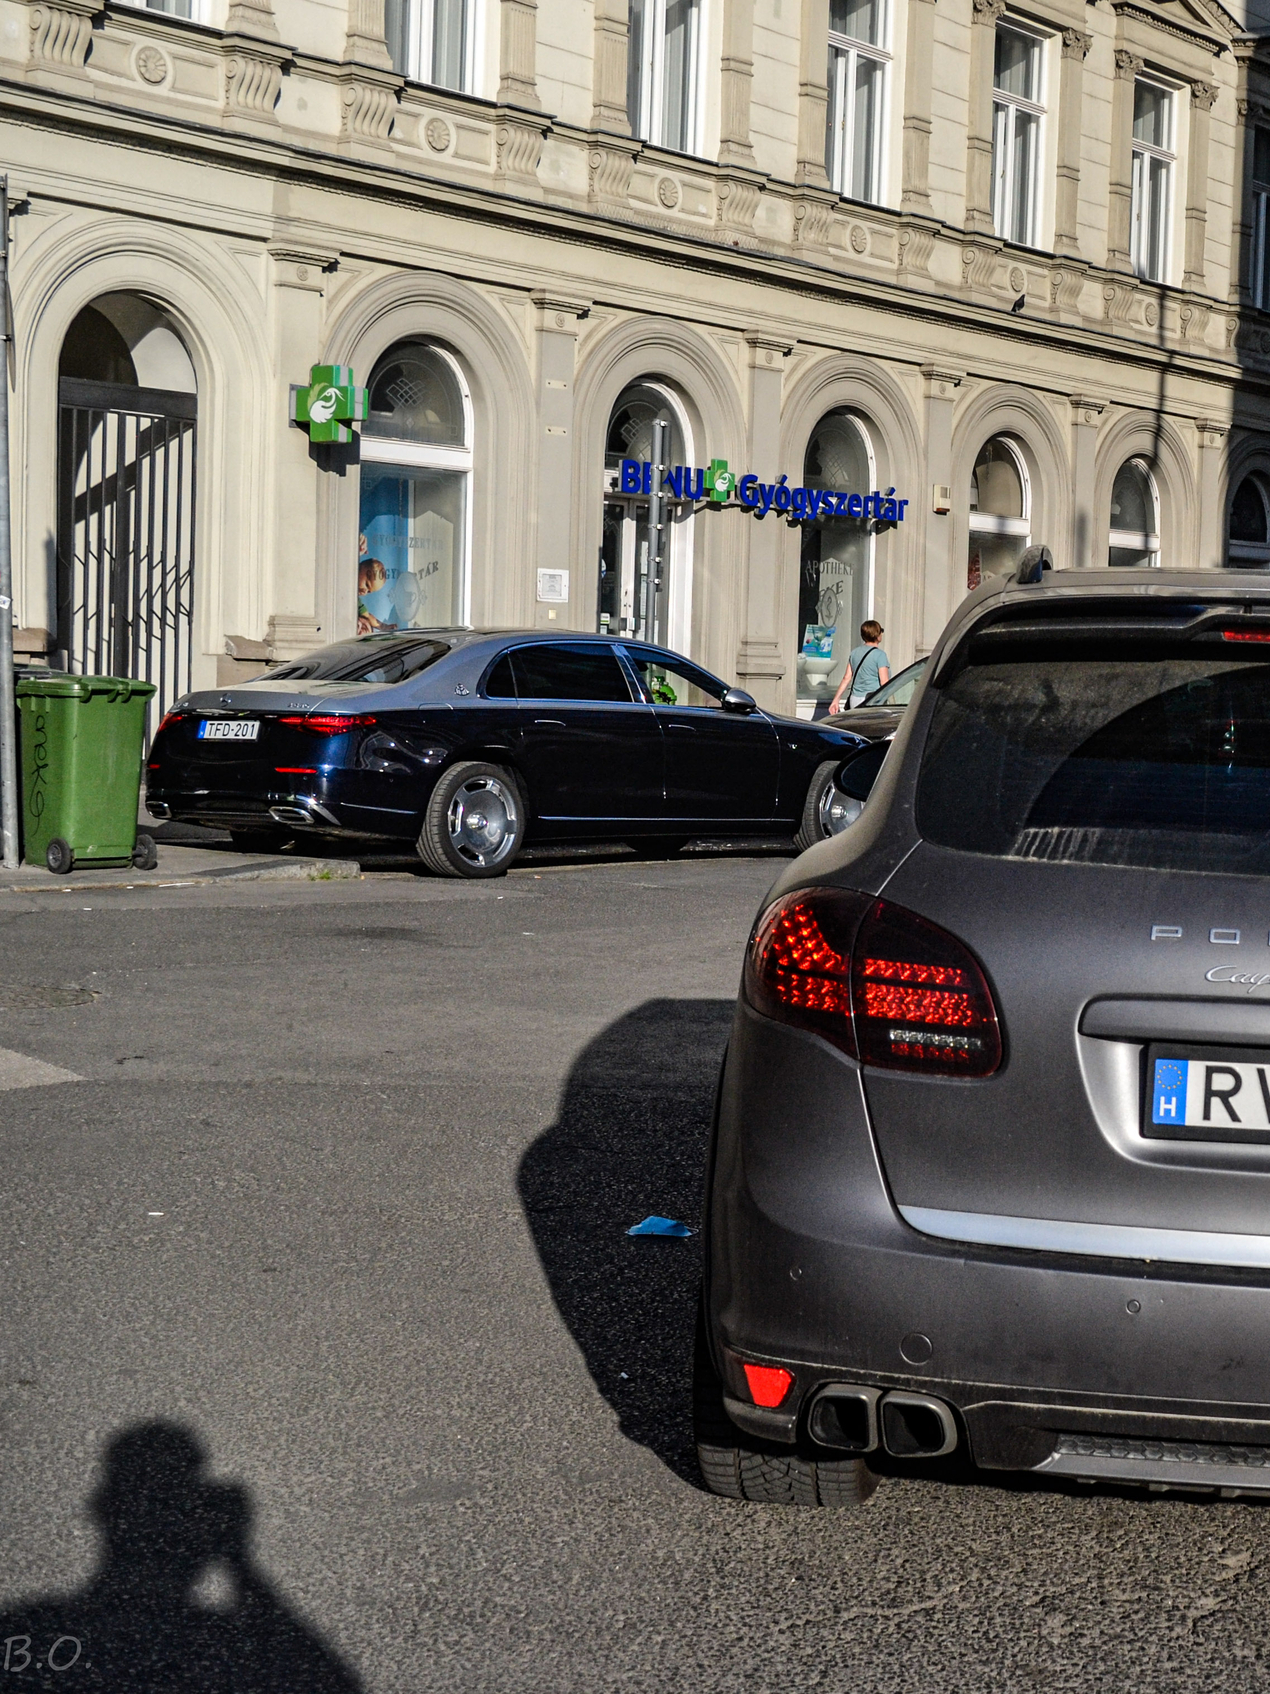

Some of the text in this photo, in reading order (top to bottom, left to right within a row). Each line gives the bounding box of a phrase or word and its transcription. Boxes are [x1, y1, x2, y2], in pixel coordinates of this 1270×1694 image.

[738, 474, 909, 522] Gyógyszertár
[208, 722, 256, 738] TFD-201
[1158, 1095, 1177, 1117] H
